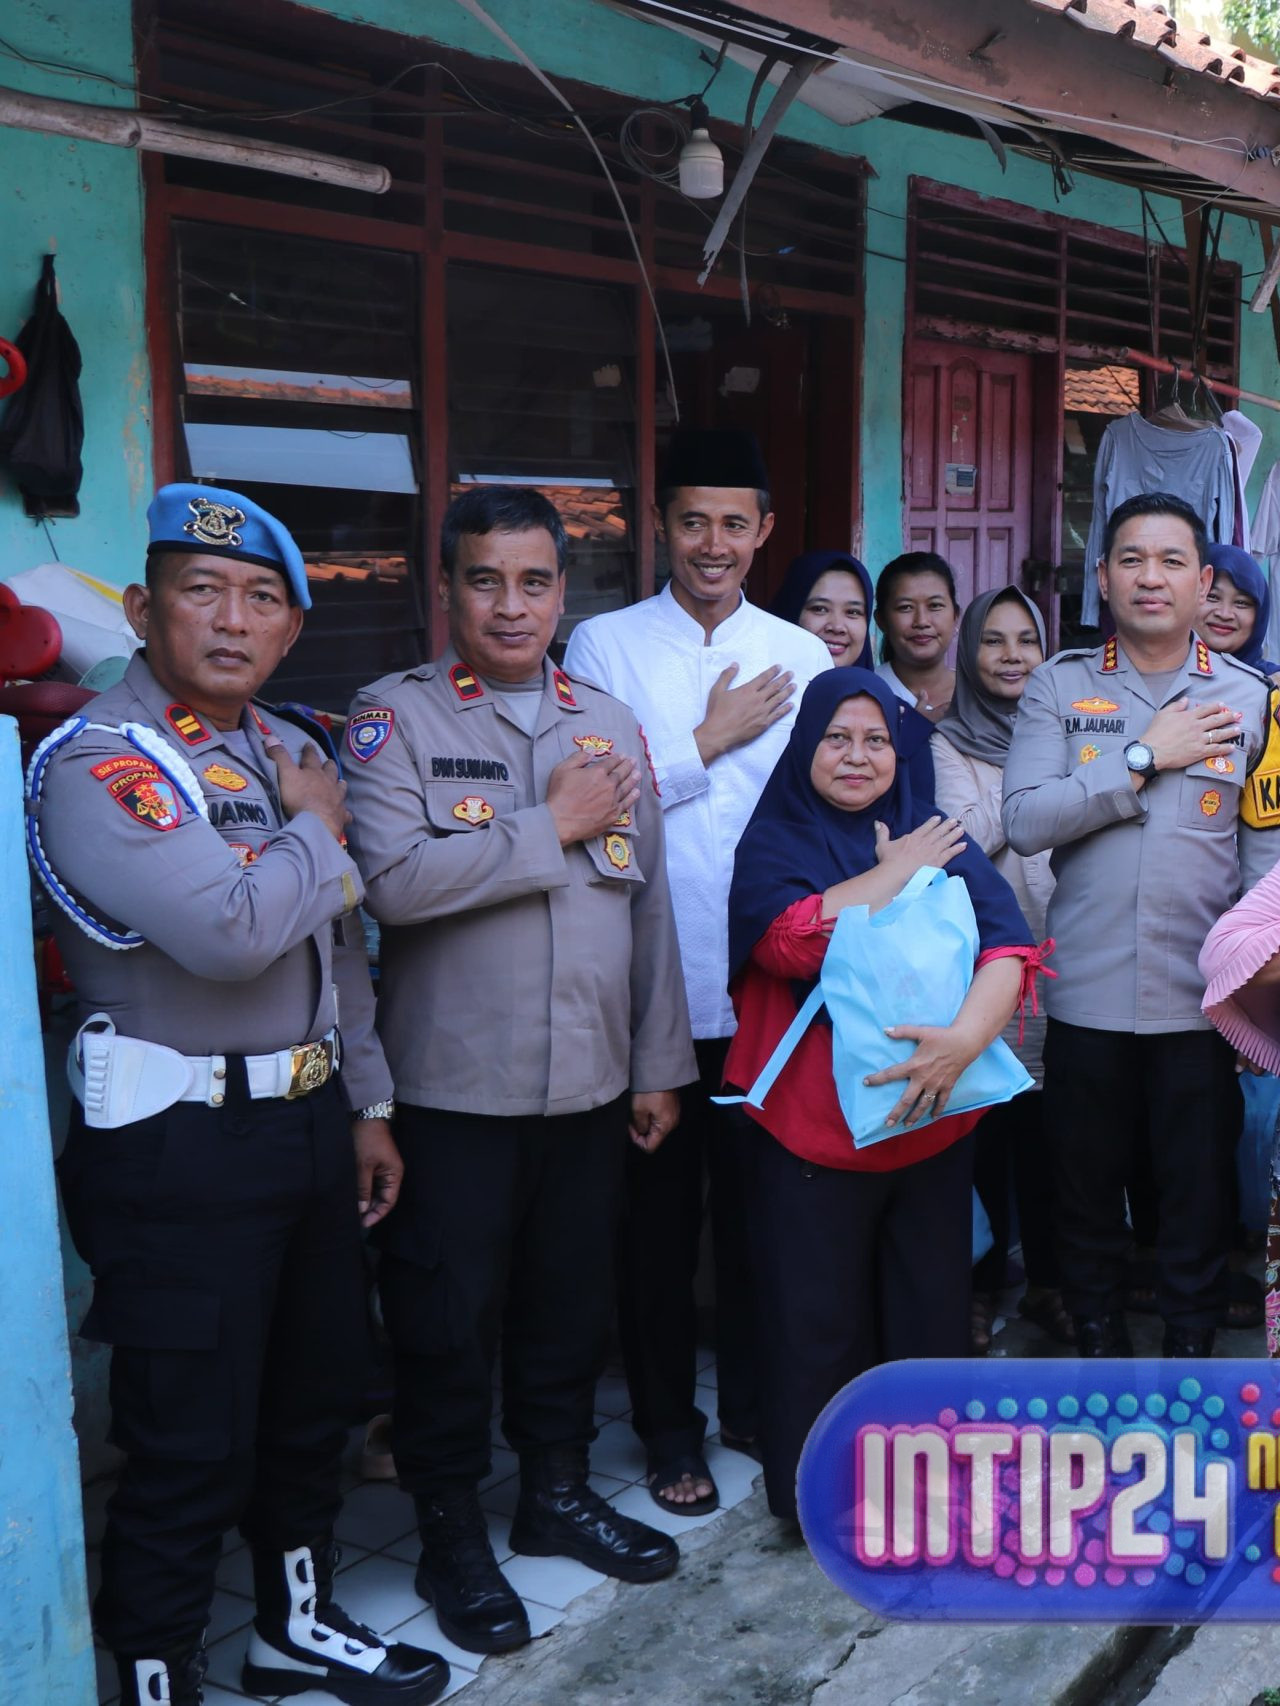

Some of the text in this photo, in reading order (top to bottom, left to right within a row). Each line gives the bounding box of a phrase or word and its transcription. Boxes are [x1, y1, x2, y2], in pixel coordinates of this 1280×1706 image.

[353, 711, 388, 724] BINMAS
[98, 760, 153, 776] SIE PROPAM
[111, 771, 159, 792] PROPAM
